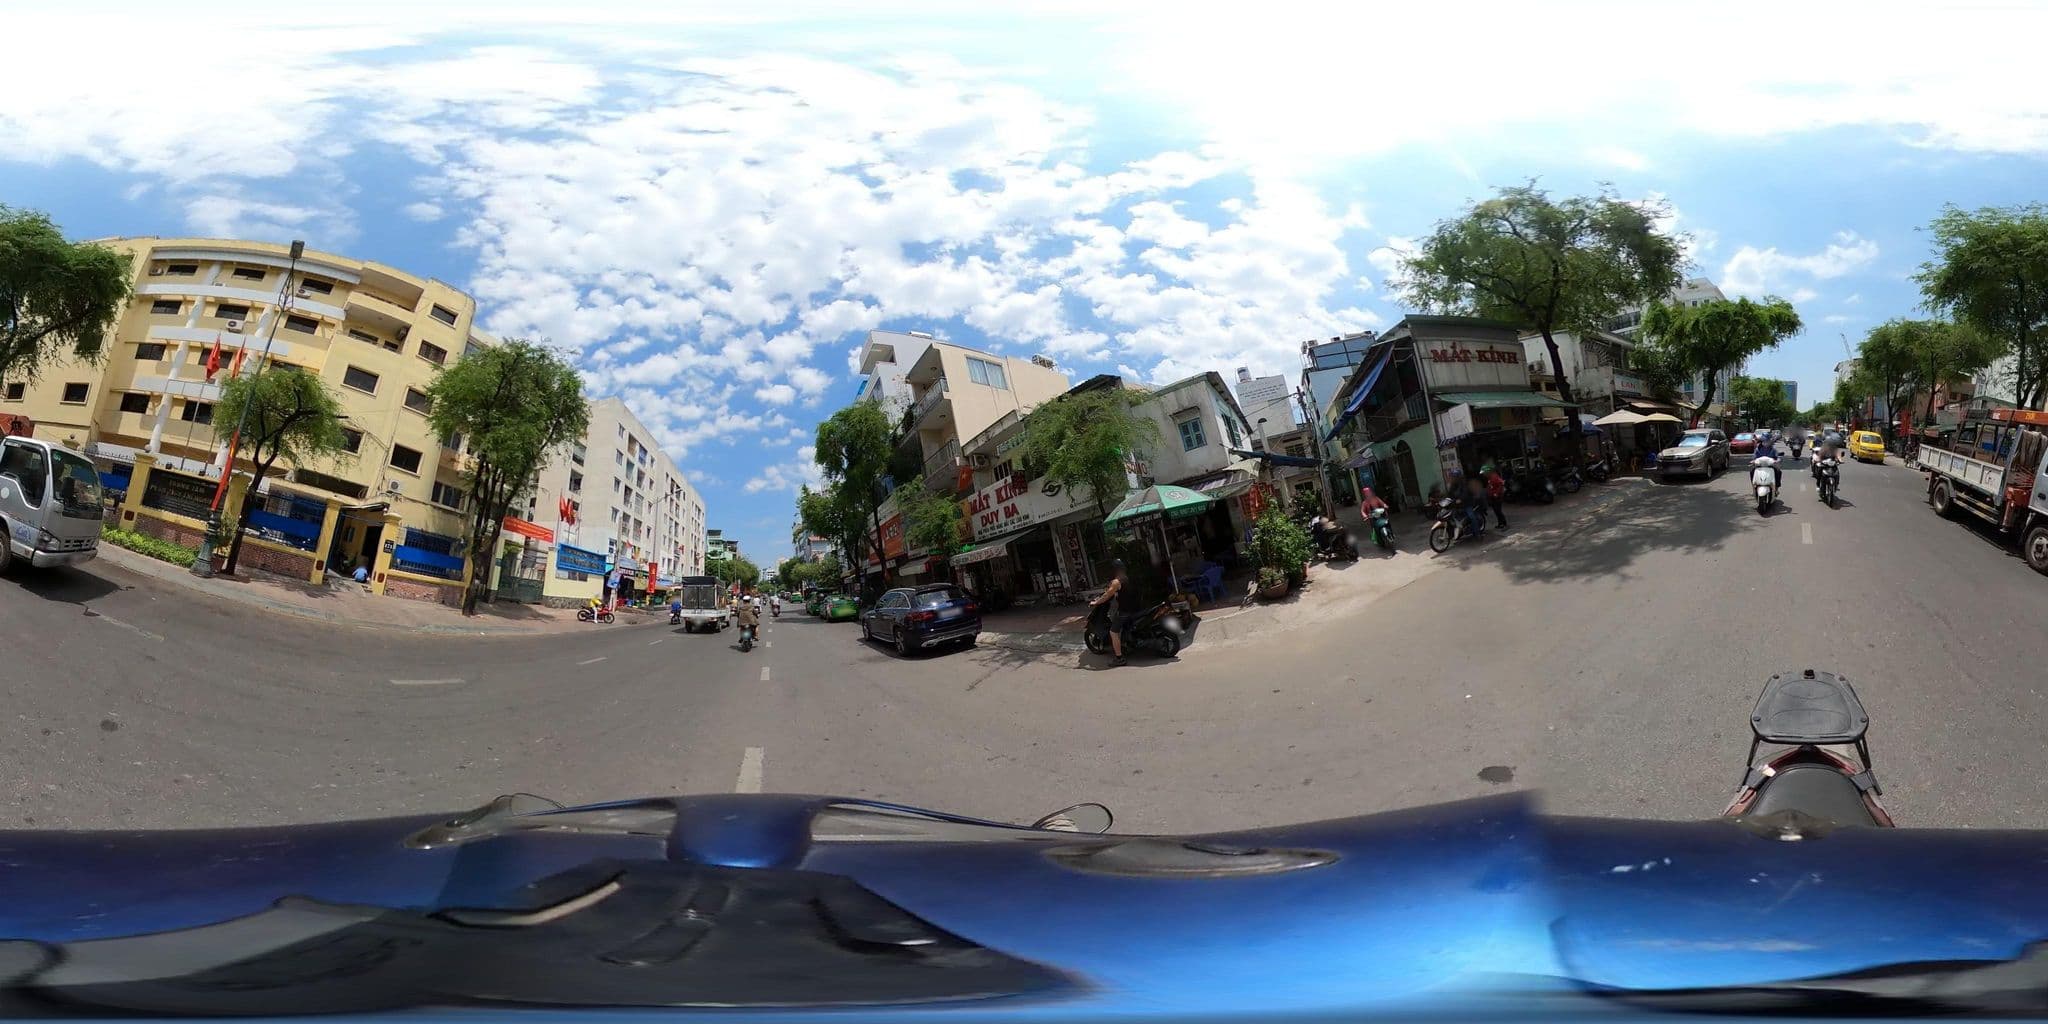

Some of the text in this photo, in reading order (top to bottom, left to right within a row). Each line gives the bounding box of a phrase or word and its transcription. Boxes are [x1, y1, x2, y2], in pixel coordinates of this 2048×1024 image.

[1431, 340, 1519, 364] MẮT KÍNH
[980, 509, 999, 528] DUY
[1003, 502, 1020, 519] BA
